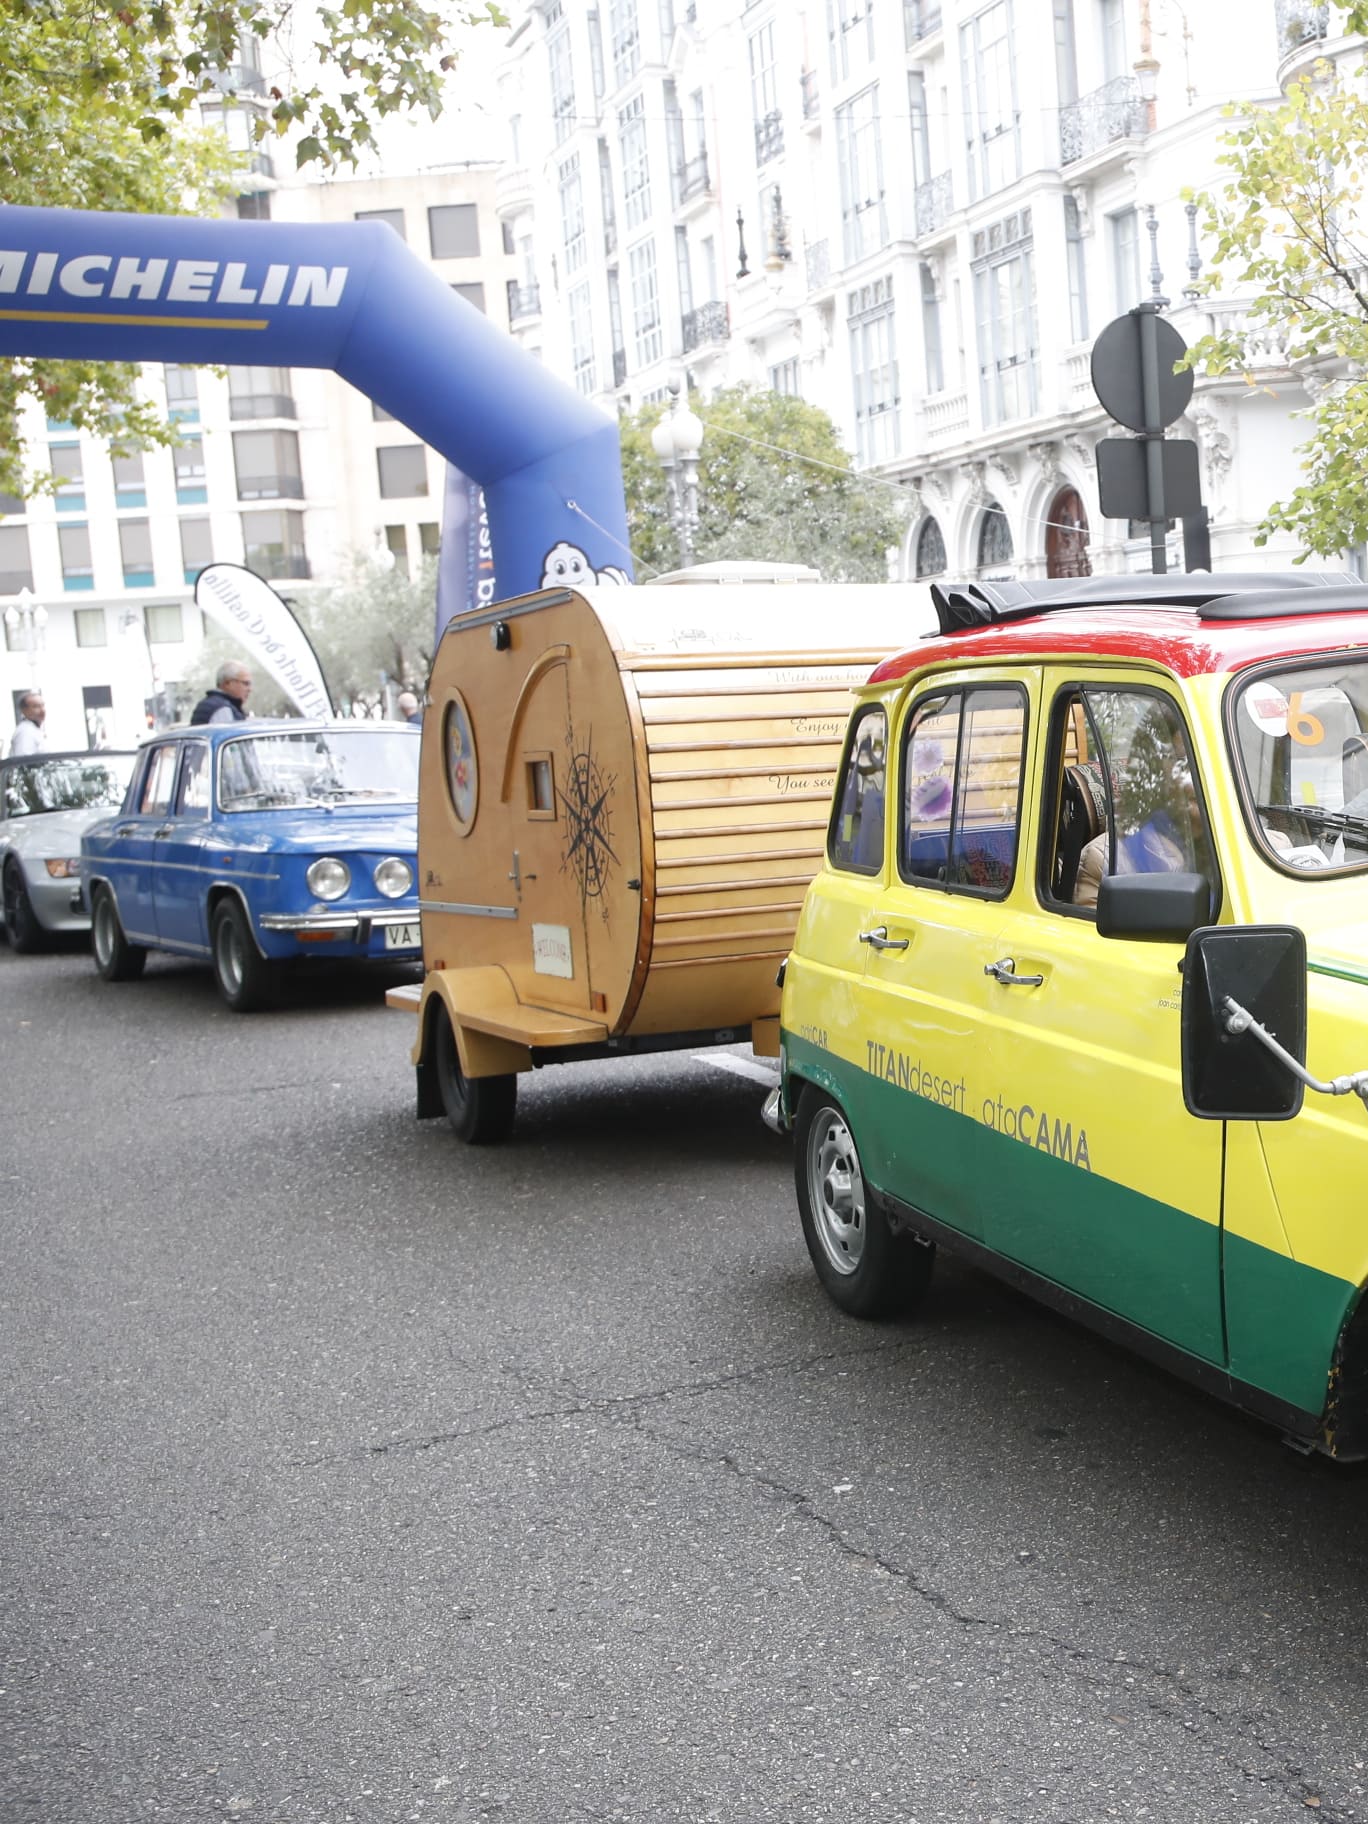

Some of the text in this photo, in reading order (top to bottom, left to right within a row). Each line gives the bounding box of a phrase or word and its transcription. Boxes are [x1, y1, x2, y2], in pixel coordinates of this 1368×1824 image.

[791, 718, 840, 737] Enjoy
[1287, 692, 1325, 746] 6
[769, 775, 834, 794] You see
